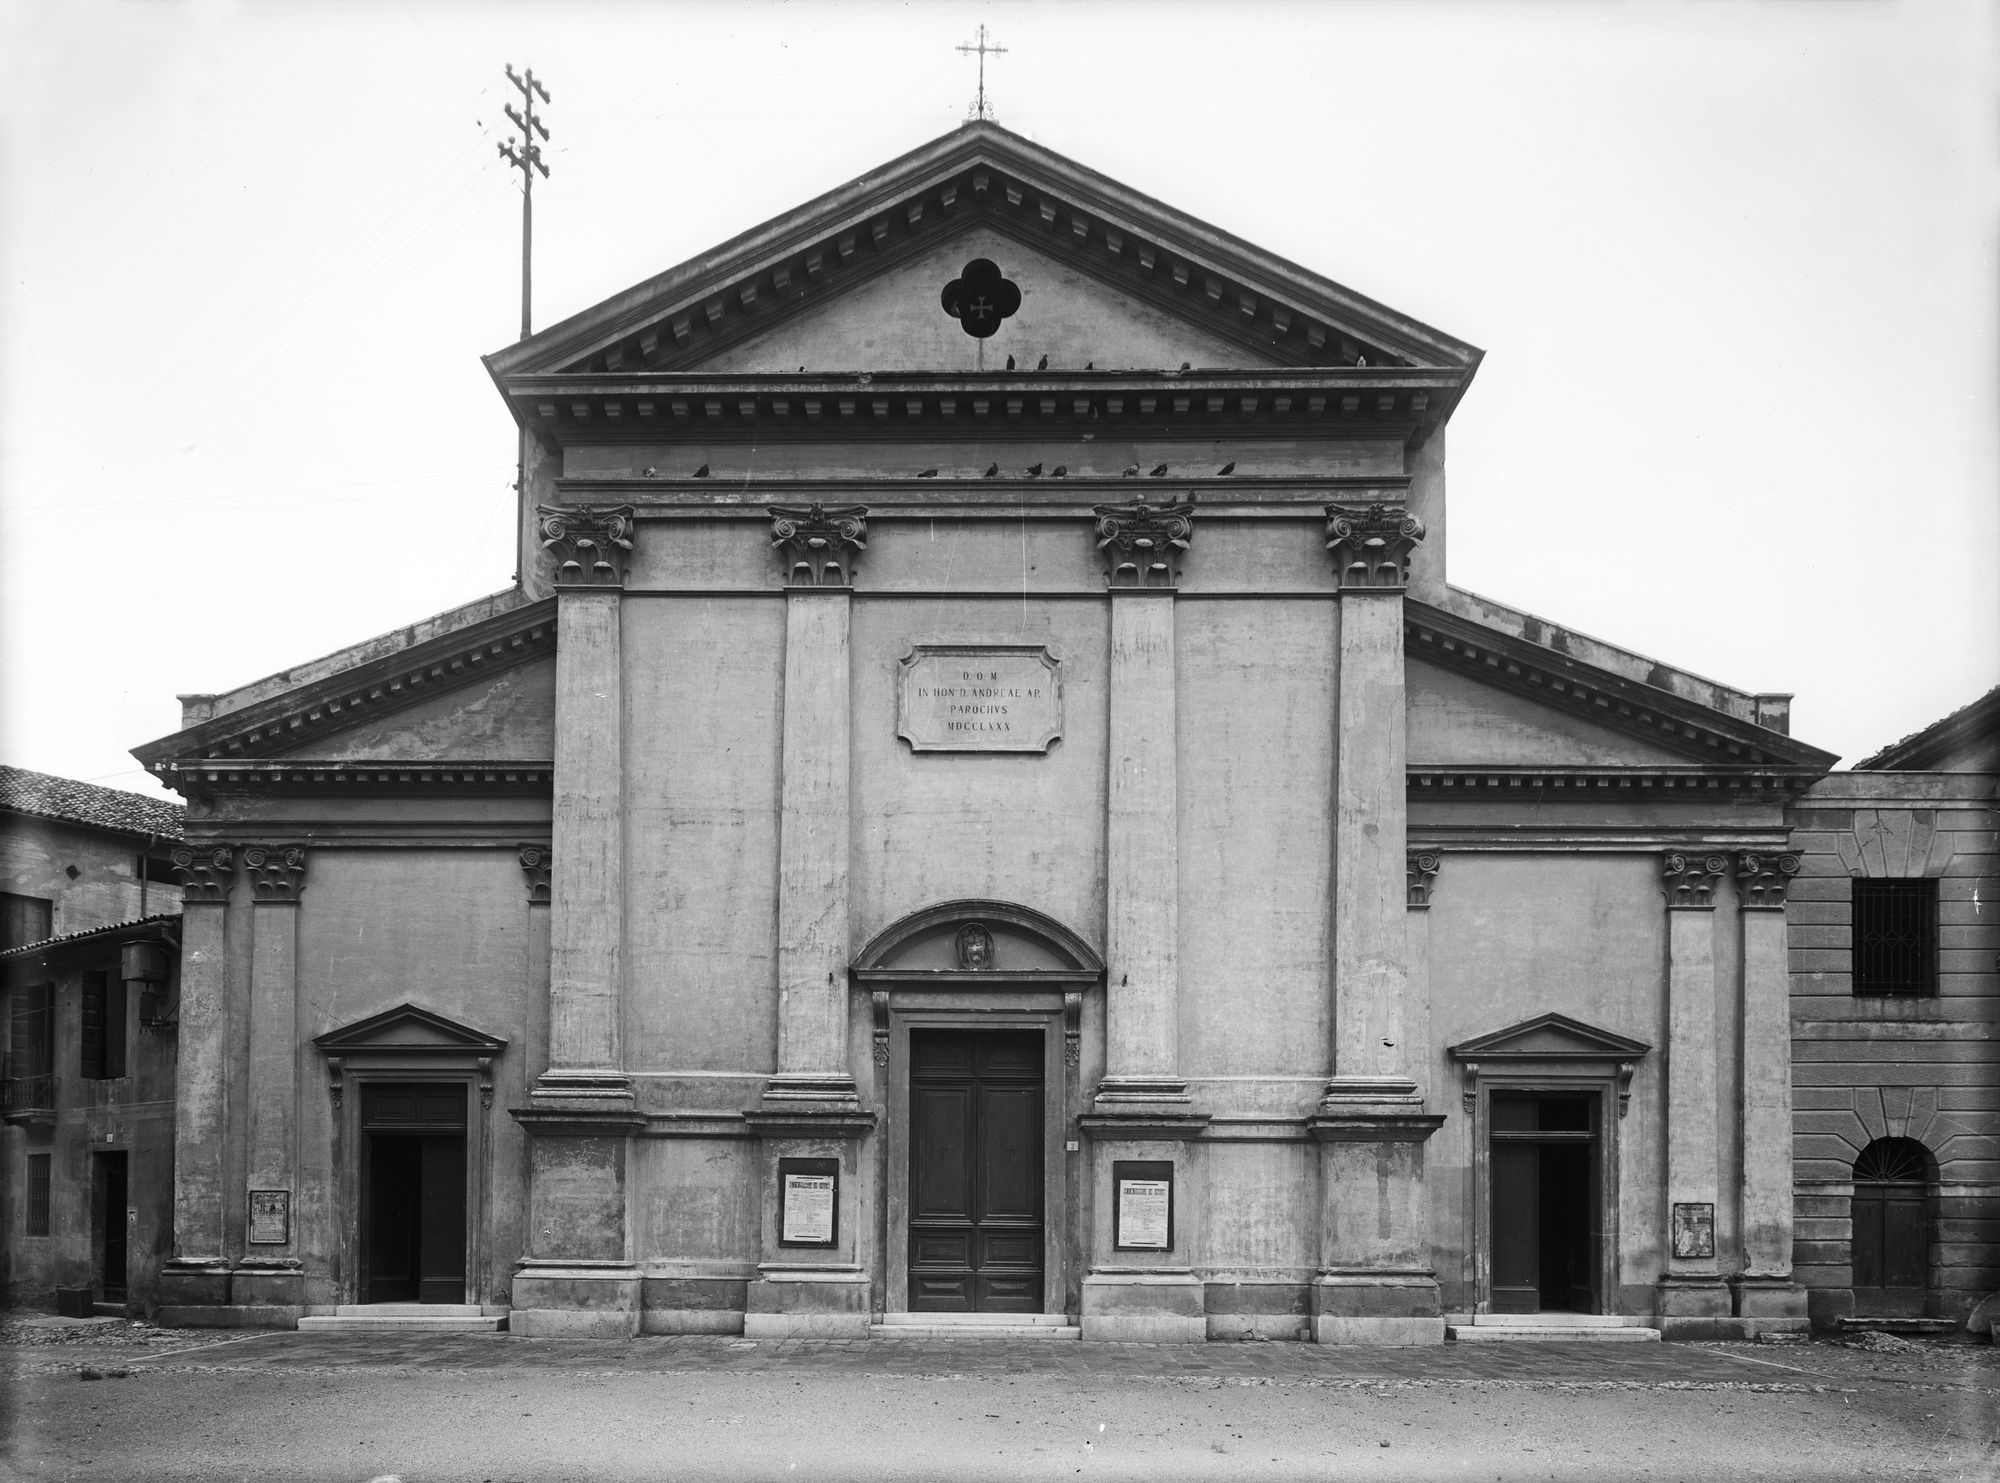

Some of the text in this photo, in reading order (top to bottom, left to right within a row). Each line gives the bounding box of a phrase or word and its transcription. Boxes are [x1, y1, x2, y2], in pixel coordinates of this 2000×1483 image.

[918, 687, 928, 697] IN
[972, 687, 1021, 697] ANDREAE
[950, 705, 1008, 714] PAROCHVS
[948, 721, 1010, 731] MDCCLXXX
